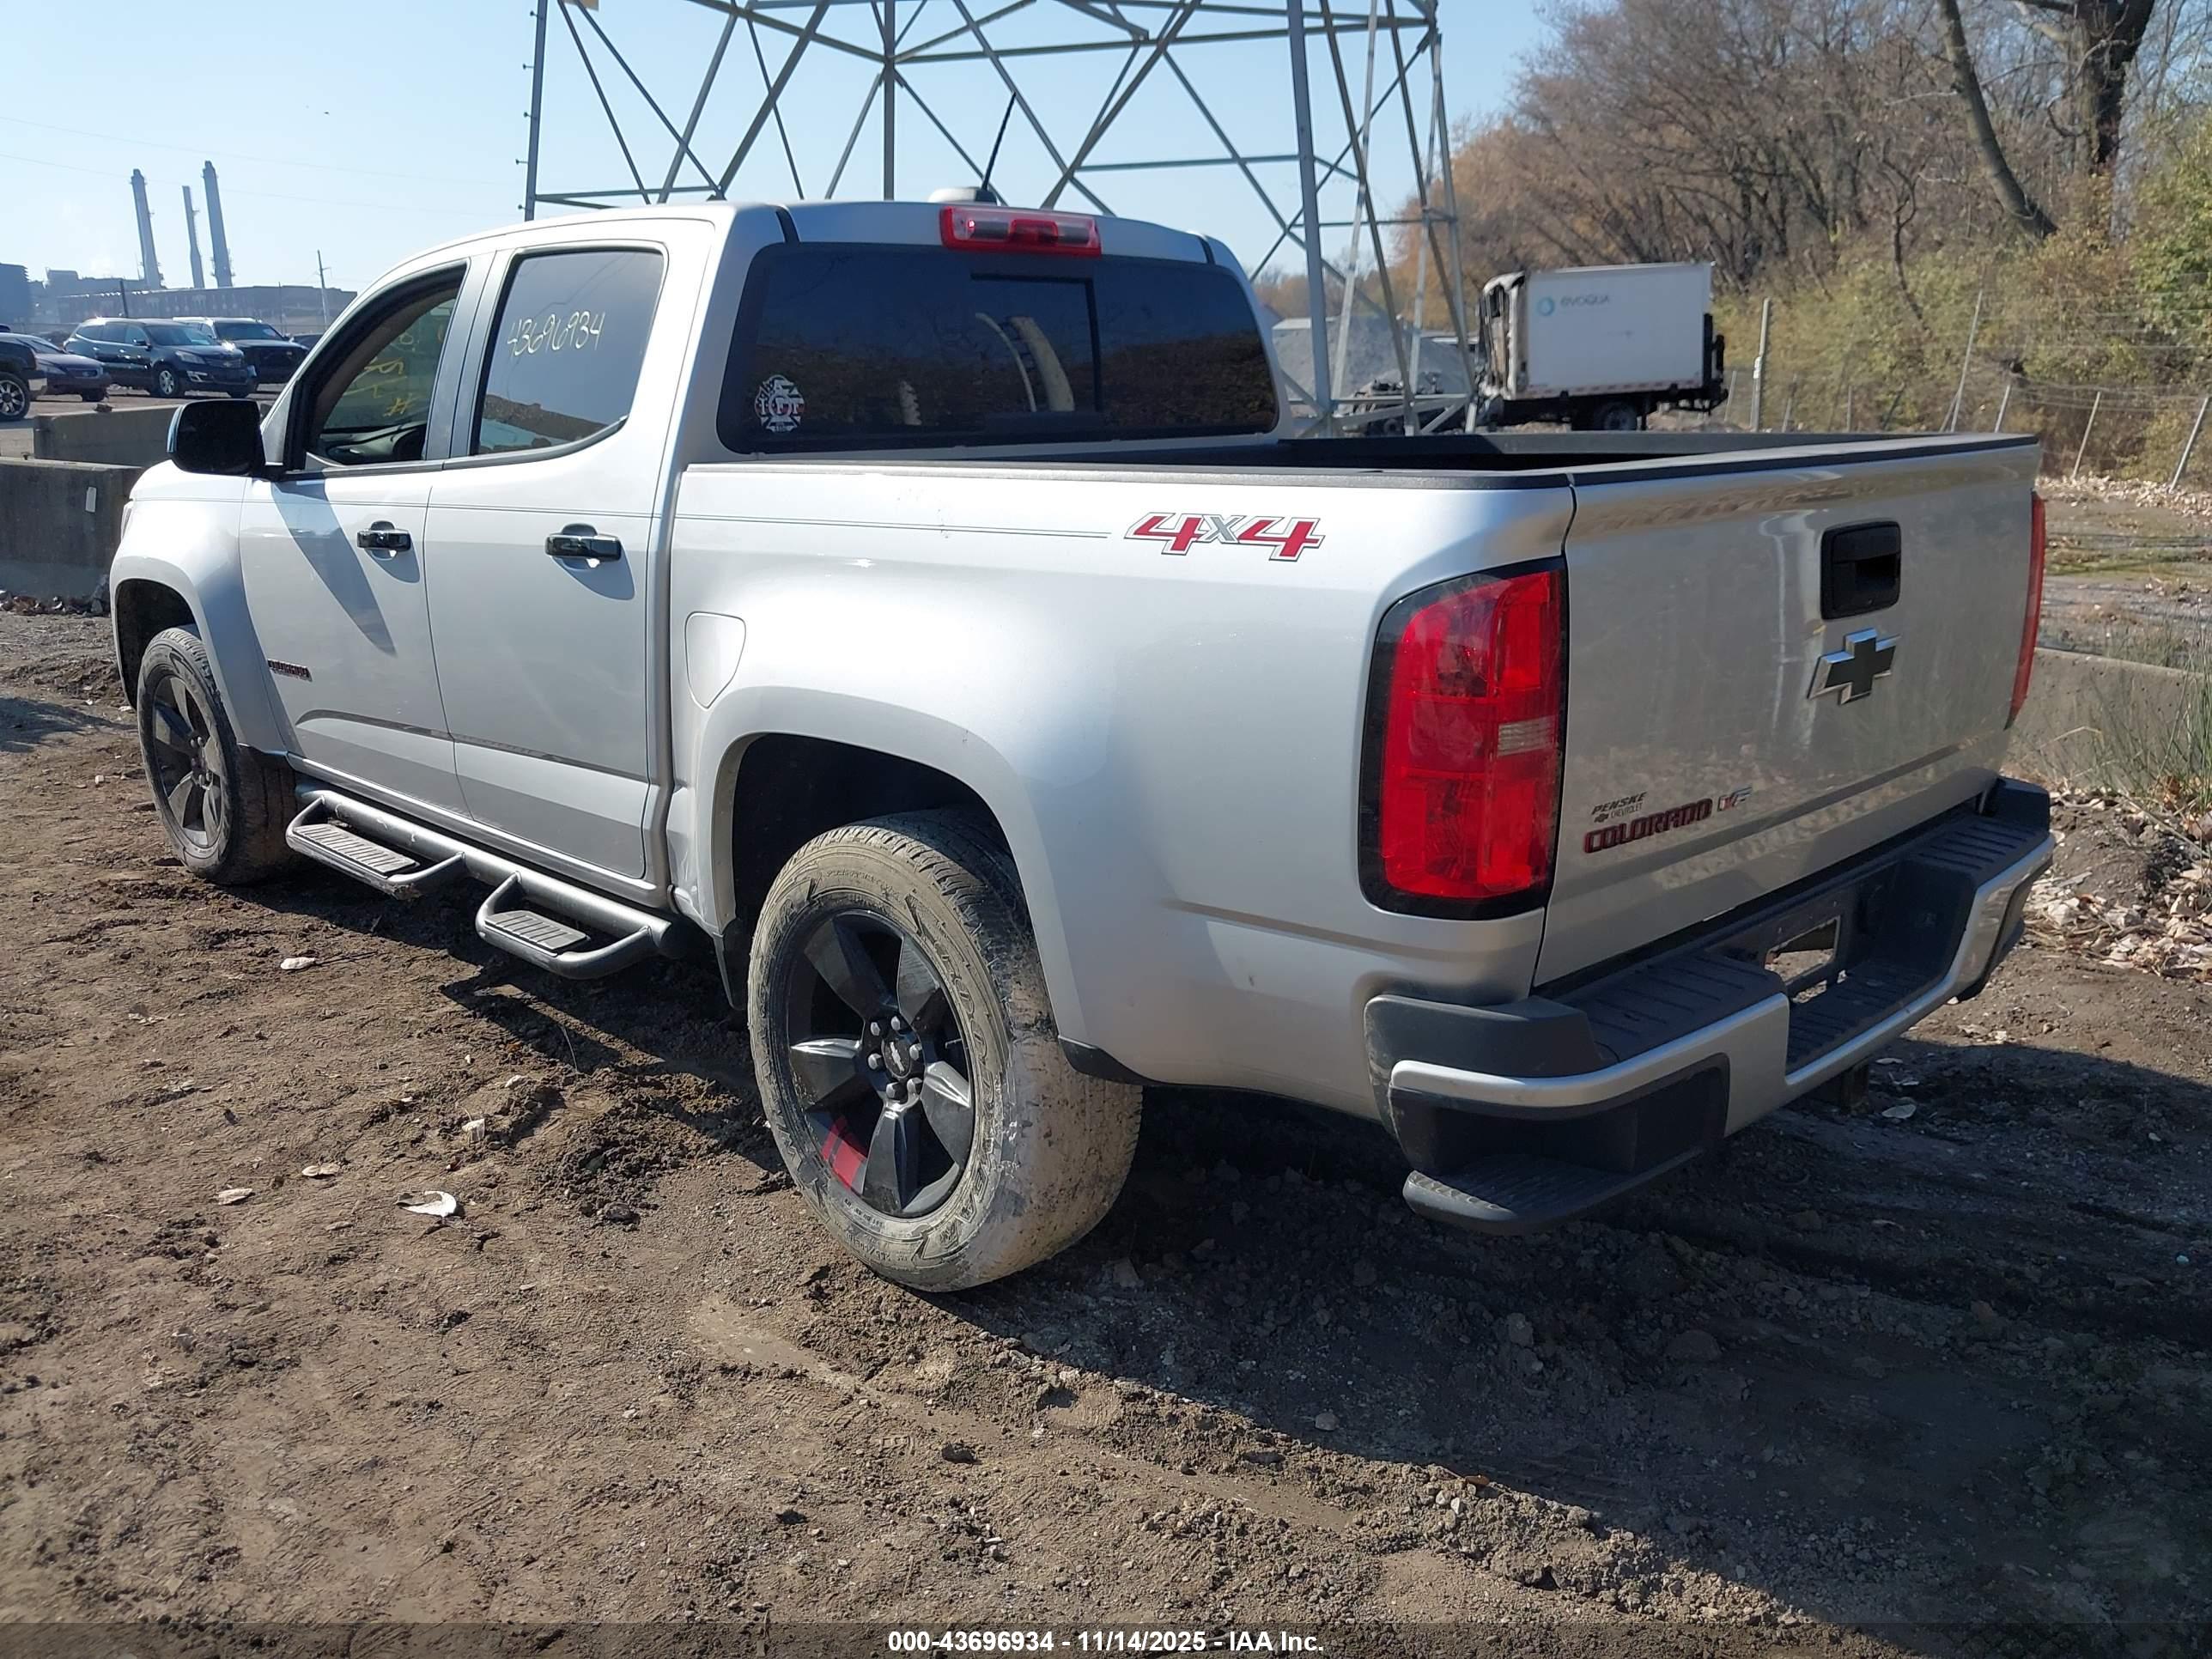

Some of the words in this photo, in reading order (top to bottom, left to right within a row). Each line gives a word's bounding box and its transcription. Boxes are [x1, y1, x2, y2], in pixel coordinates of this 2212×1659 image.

[507, 311, 605, 359] 43696934
[1583, 798, 1713, 854] COLORADO
[1591, 792, 1648, 815] PENSKE
